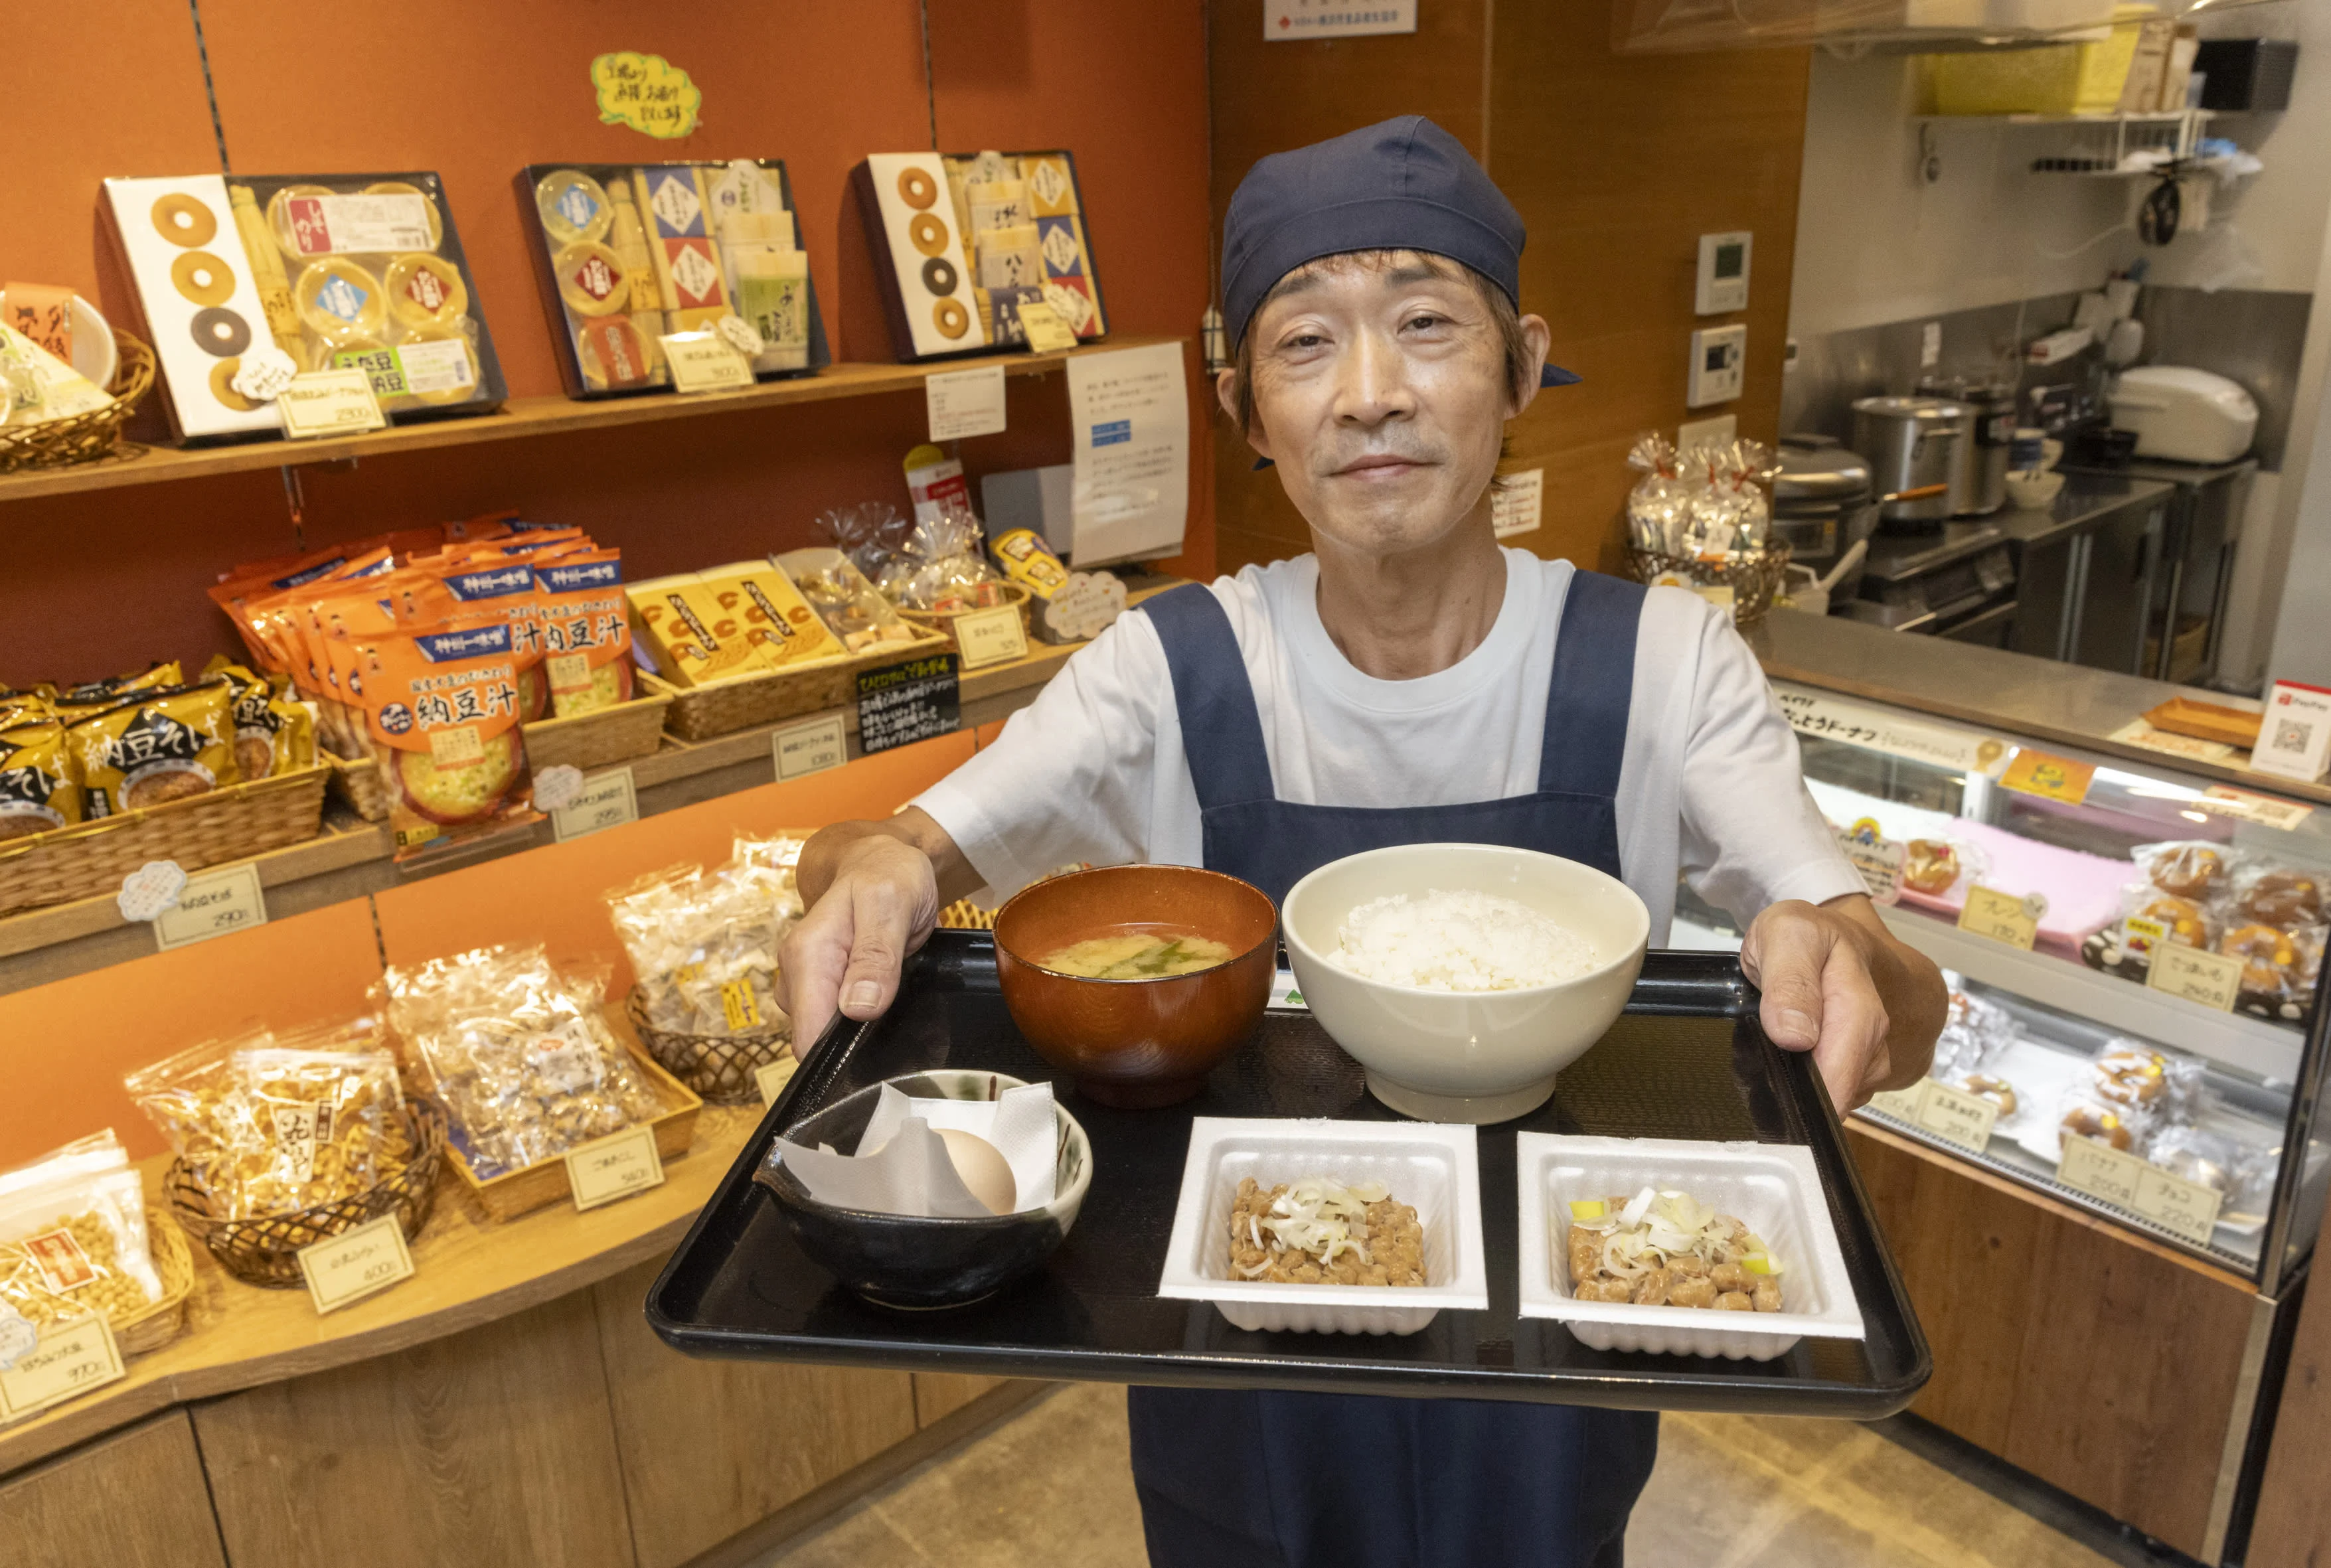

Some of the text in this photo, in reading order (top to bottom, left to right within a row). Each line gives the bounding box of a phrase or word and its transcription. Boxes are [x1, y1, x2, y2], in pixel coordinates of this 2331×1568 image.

[417, 682, 517, 725] 納豆汁
[84, 708, 224, 771] 納豆そば
[0, 751, 72, 801] そば
